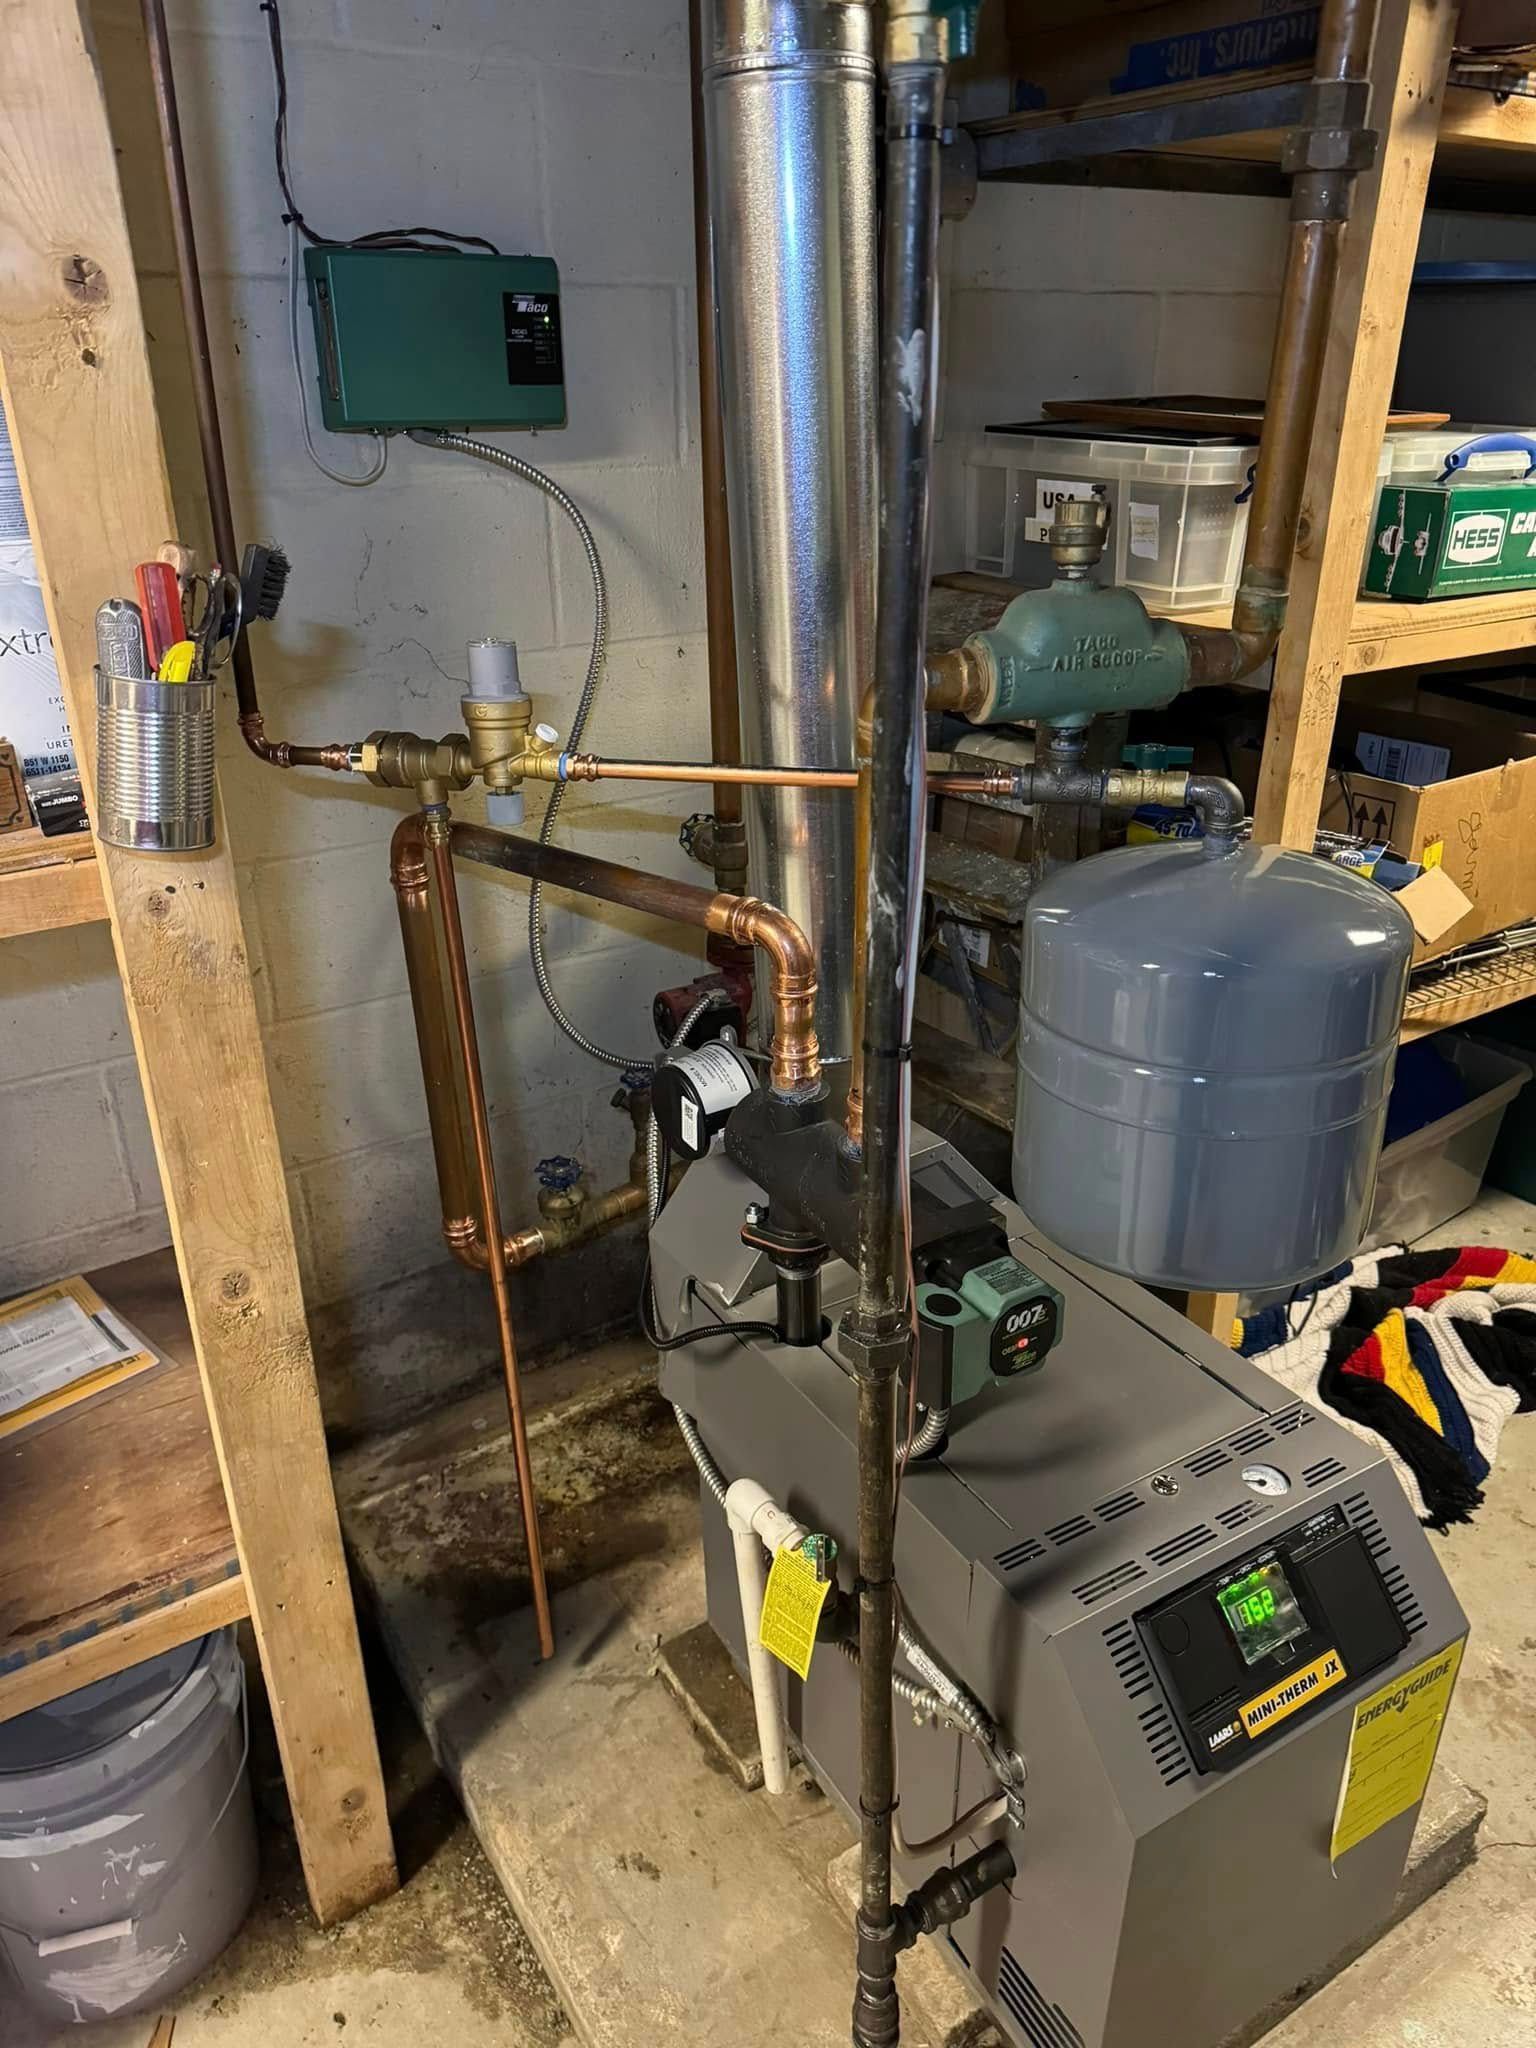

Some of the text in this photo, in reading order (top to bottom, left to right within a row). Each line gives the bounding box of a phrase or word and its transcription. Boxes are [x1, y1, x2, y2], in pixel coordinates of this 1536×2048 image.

[1453, 527, 1500, 550] HESS
[0, 628, 54, 657] xtr
[1052, 655, 1084, 672] AIR
[51, 754, 70, 764] 1150
[1336, 853, 1363, 868] ARGE
[1247, 1658, 1339, 1728] MINI-THERM JX
[1208, 1722, 1234, 1748] LAARS
